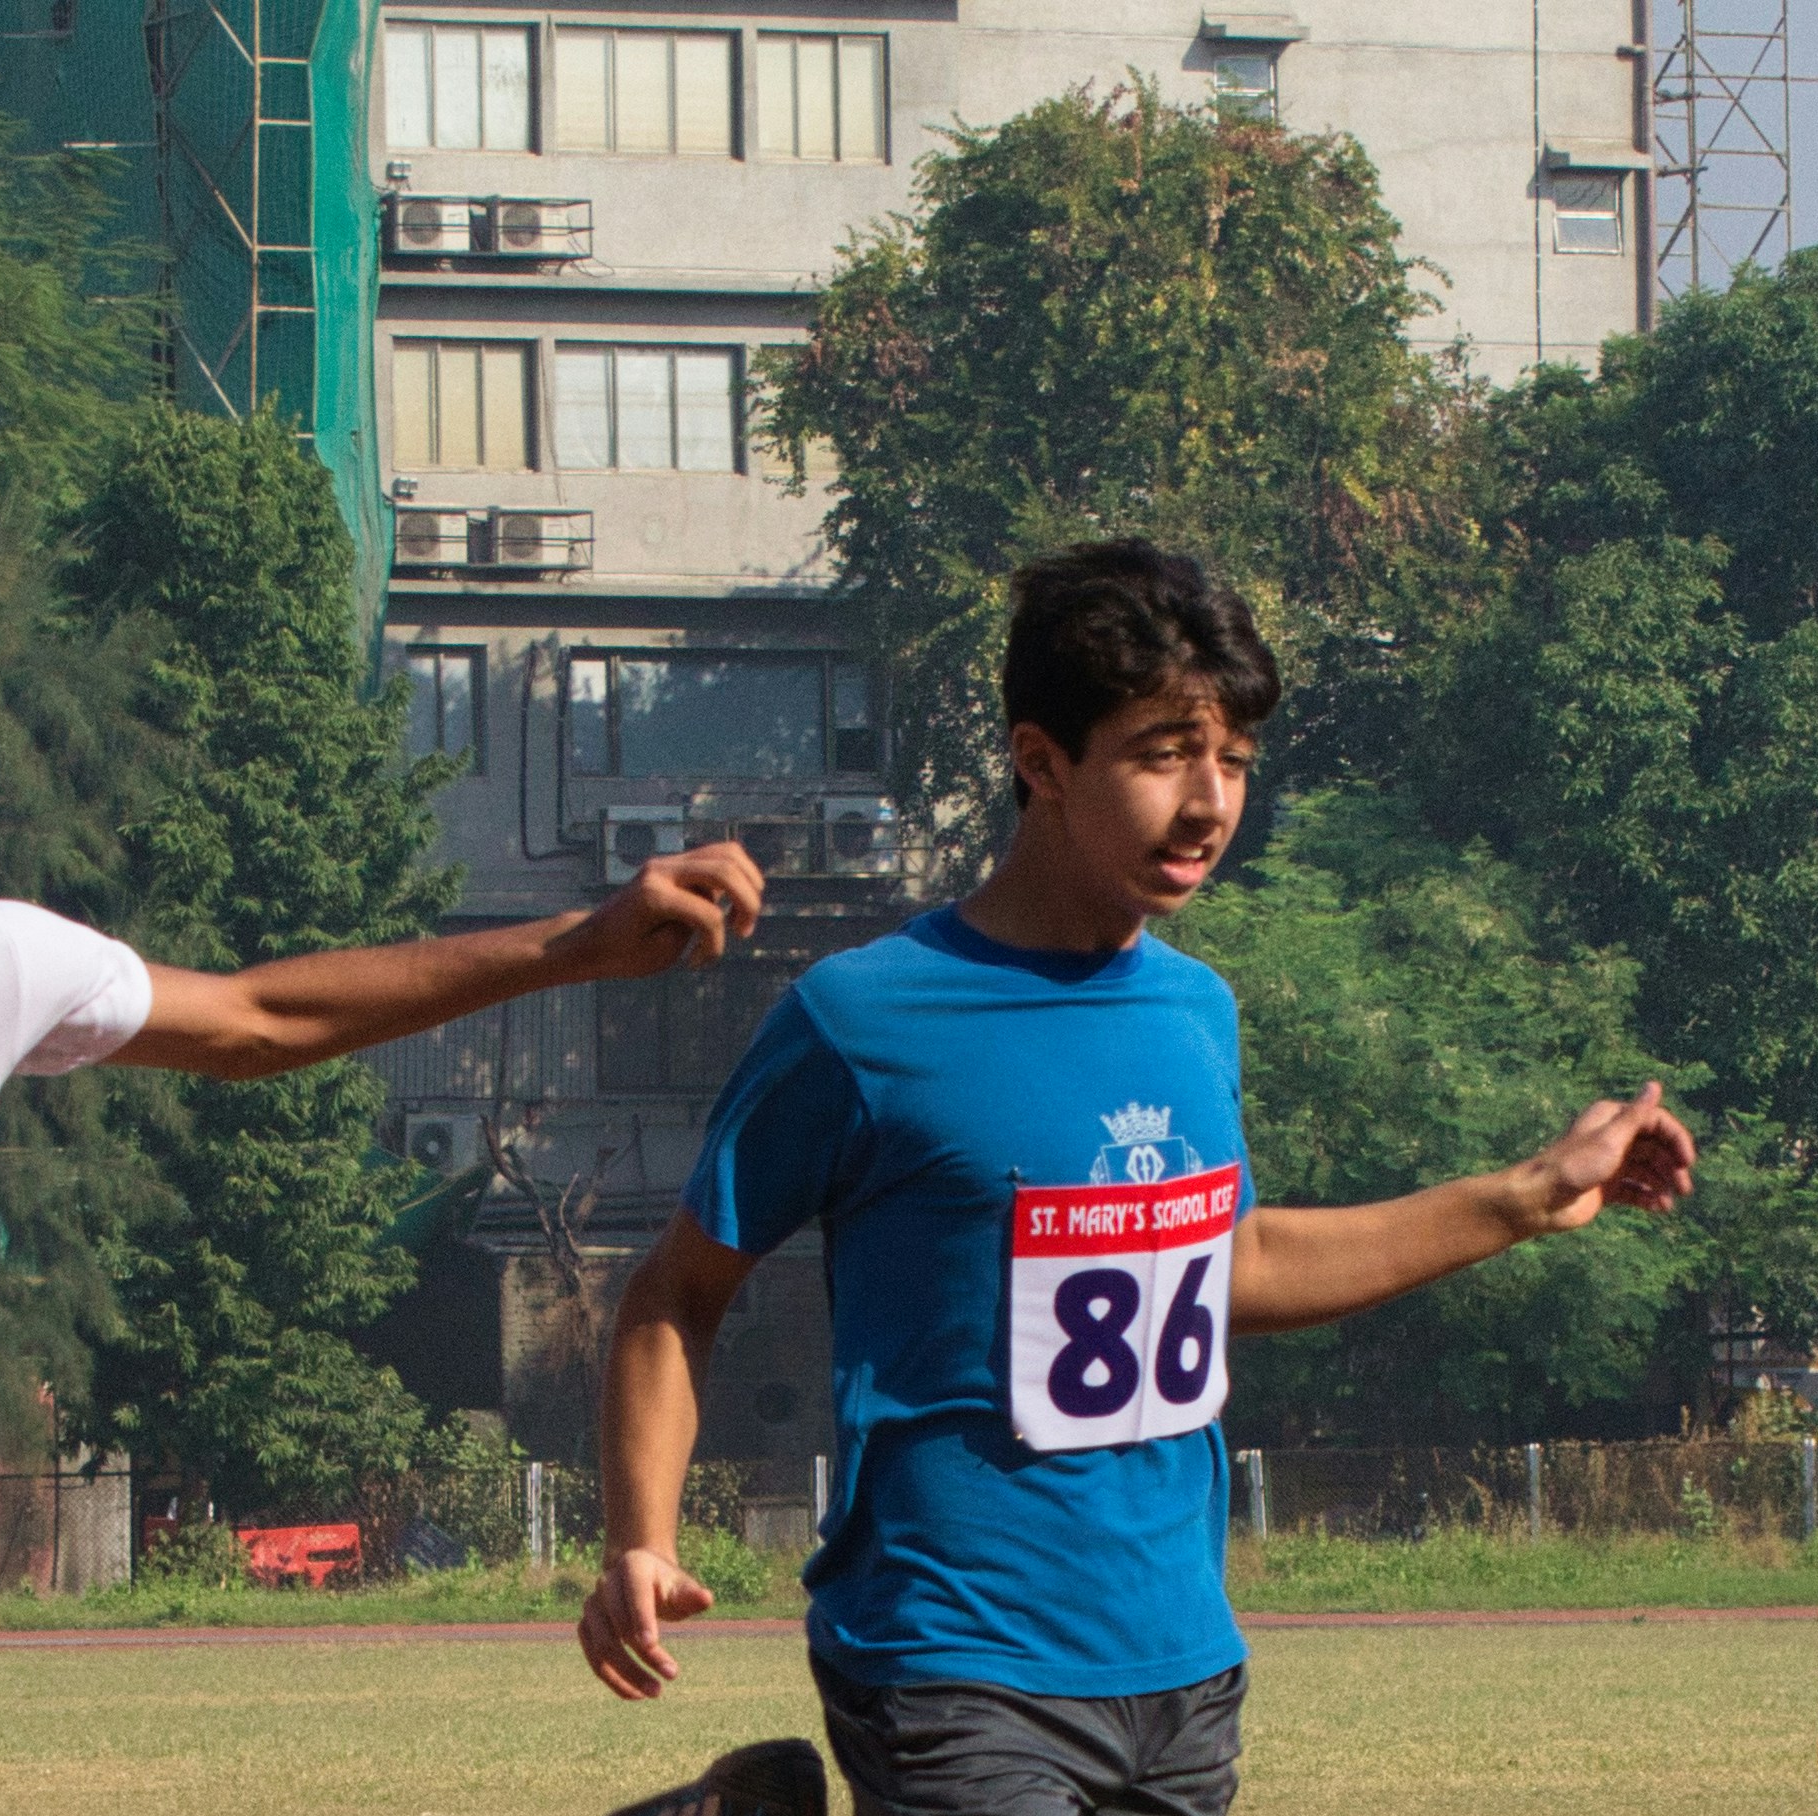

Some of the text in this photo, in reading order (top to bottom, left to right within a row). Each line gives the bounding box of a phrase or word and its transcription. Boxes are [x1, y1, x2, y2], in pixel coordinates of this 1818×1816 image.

[1029, 1205, 1061, 1237] ST.
[1067, 1201, 1147, 1238] MARY'S
[1151, 1192, 1209, 1231] SCHOOL
[1047, 1253, 1214, 1419] 86
